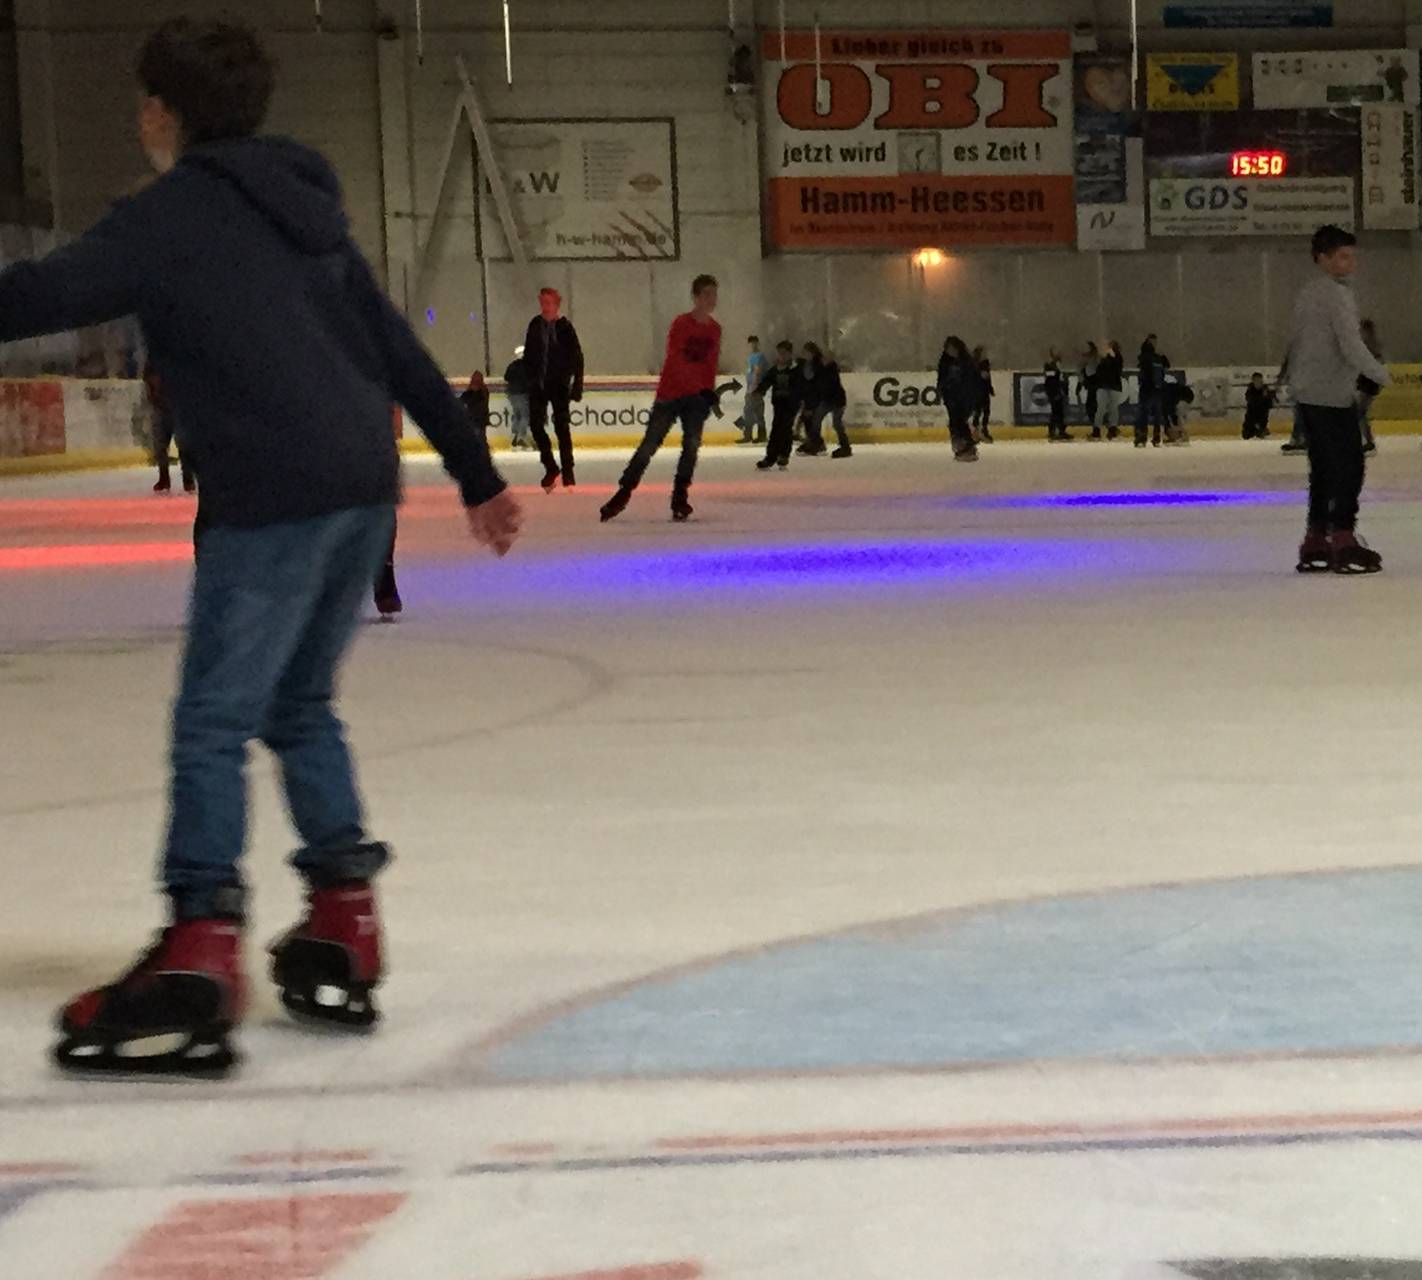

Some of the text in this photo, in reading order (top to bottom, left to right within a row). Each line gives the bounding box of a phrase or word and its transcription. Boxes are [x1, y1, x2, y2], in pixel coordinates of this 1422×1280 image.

[832, 38, 1004, 58] Lieber gleich zu
[777, 63, 1059, 130] OBI
[782, 142, 832, 167] jetzt
[839, 141, 887, 162] wird
[953, 145, 979, 162] es
[985, 141, 1030, 162] Zeit
[1231, 154, 1284, 177] 15:50
[1401, 110, 1415, 205] steinhauer
[801, 186, 1045, 214] Hamm-Heessen
[1184, 185, 1249, 210] GDS
